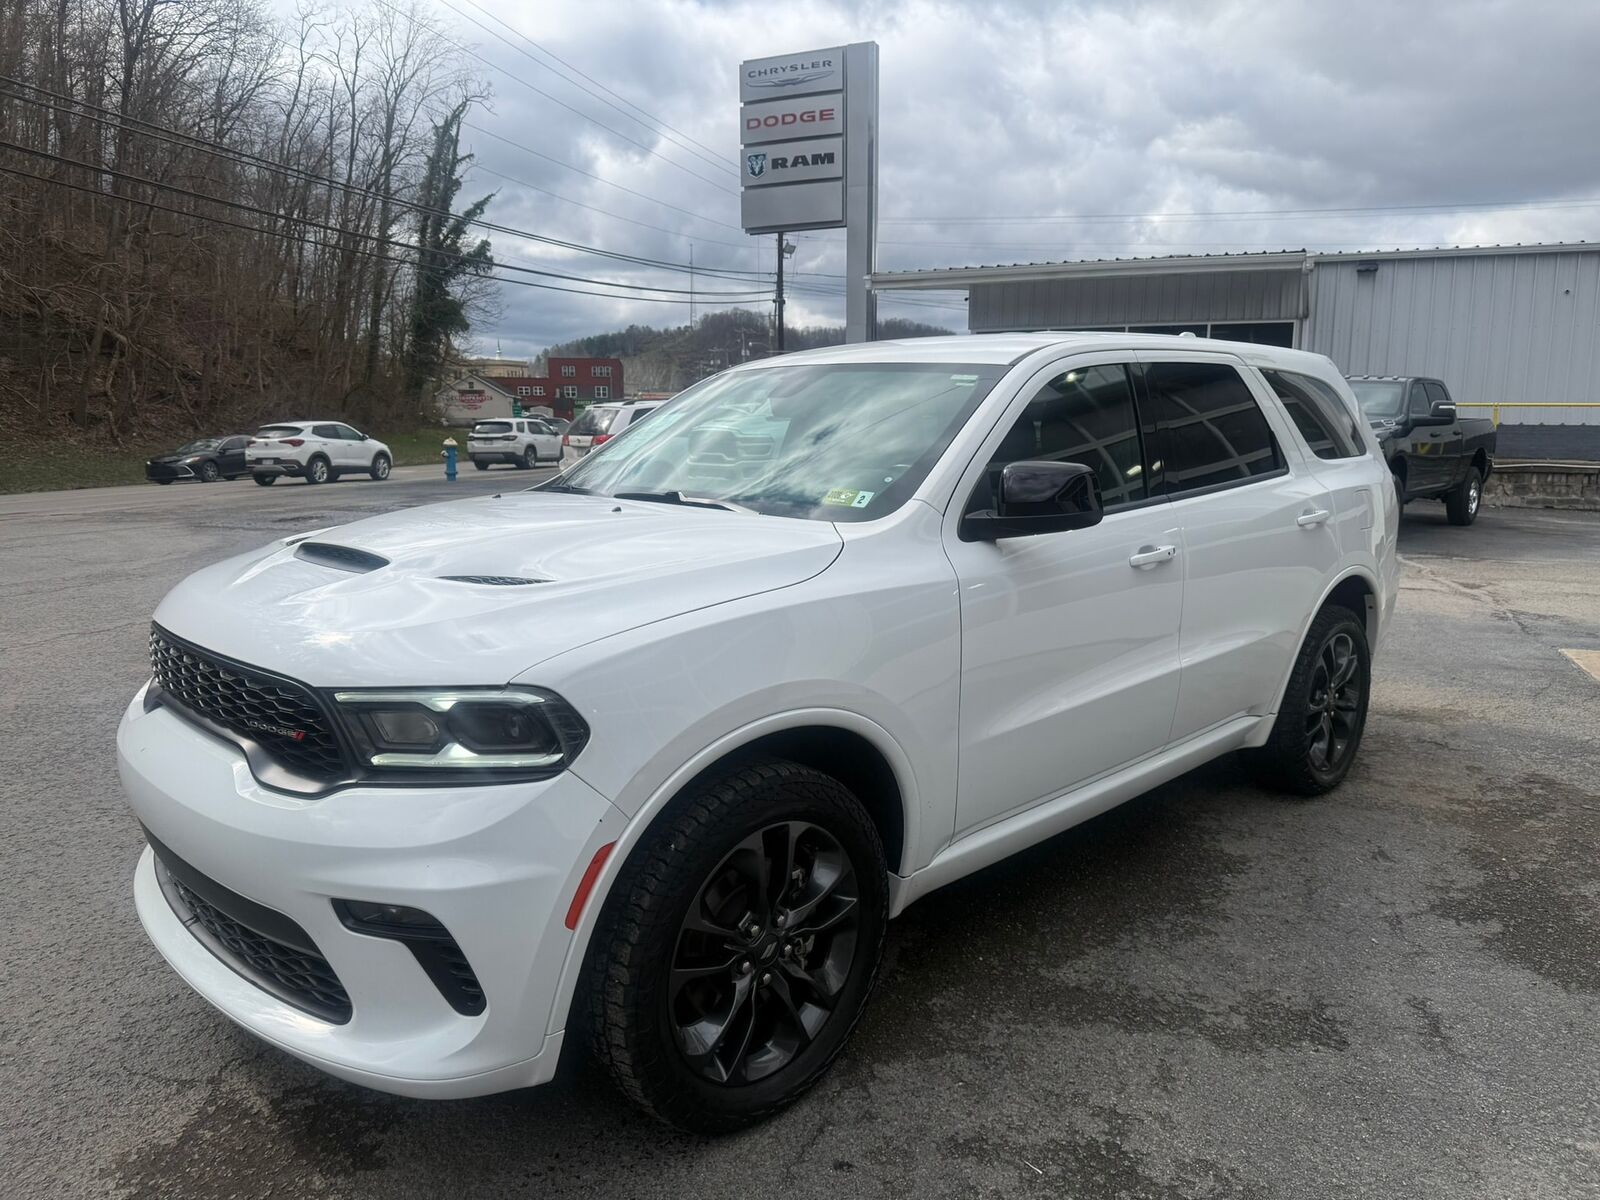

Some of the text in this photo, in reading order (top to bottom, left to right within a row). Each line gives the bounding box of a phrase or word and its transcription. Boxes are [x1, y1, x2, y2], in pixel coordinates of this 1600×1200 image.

[747, 60, 833, 79] CHRYSLER
[746, 108, 836, 130] DODGE
[771, 152, 836, 170] RAM
[856, 495, 866, 504] 2
[249, 721, 296, 738] DODGE
